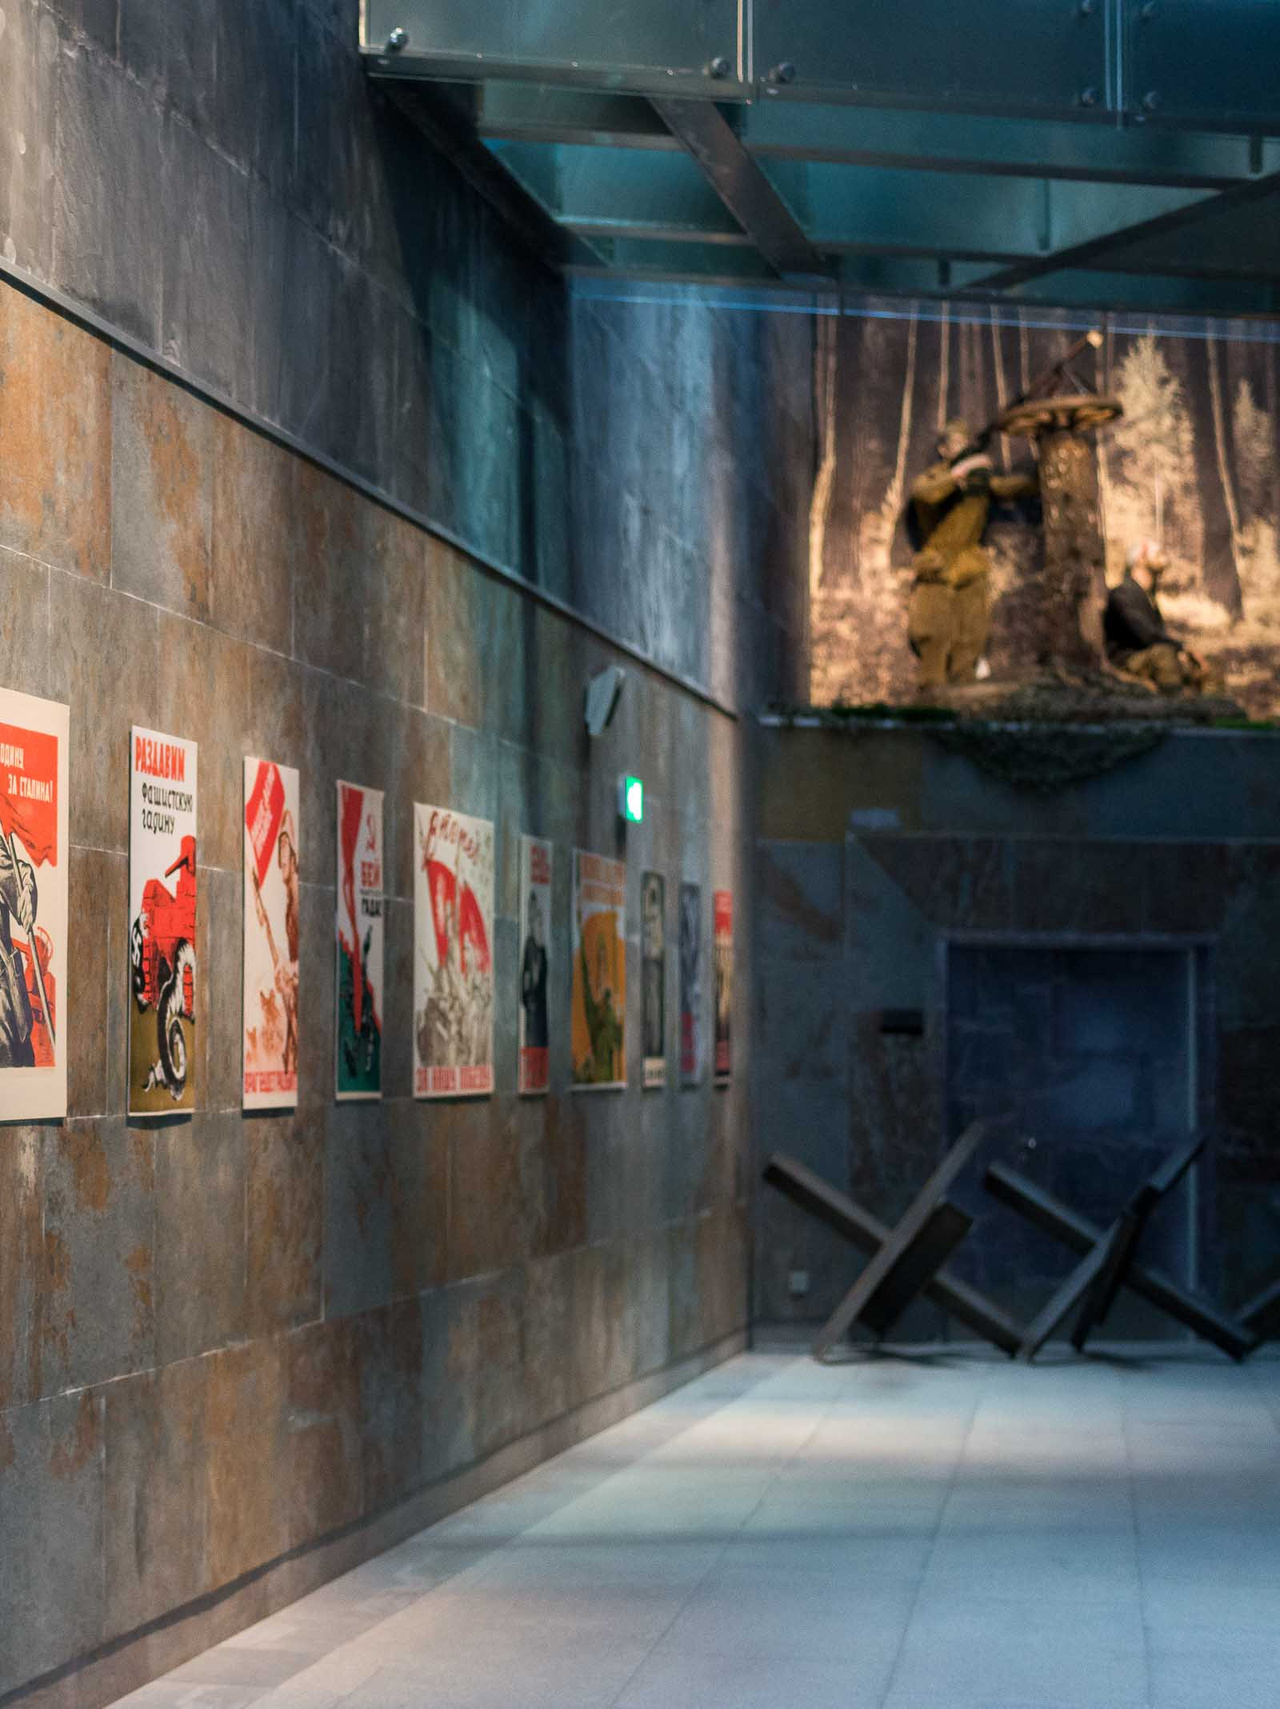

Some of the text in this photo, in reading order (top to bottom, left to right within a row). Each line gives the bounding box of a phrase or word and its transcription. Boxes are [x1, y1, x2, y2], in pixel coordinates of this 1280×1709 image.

[135, 736, 185, 782] РАЗДАВИМ
[8, 773, 53, 804] ЗА СТАЛИНА!
